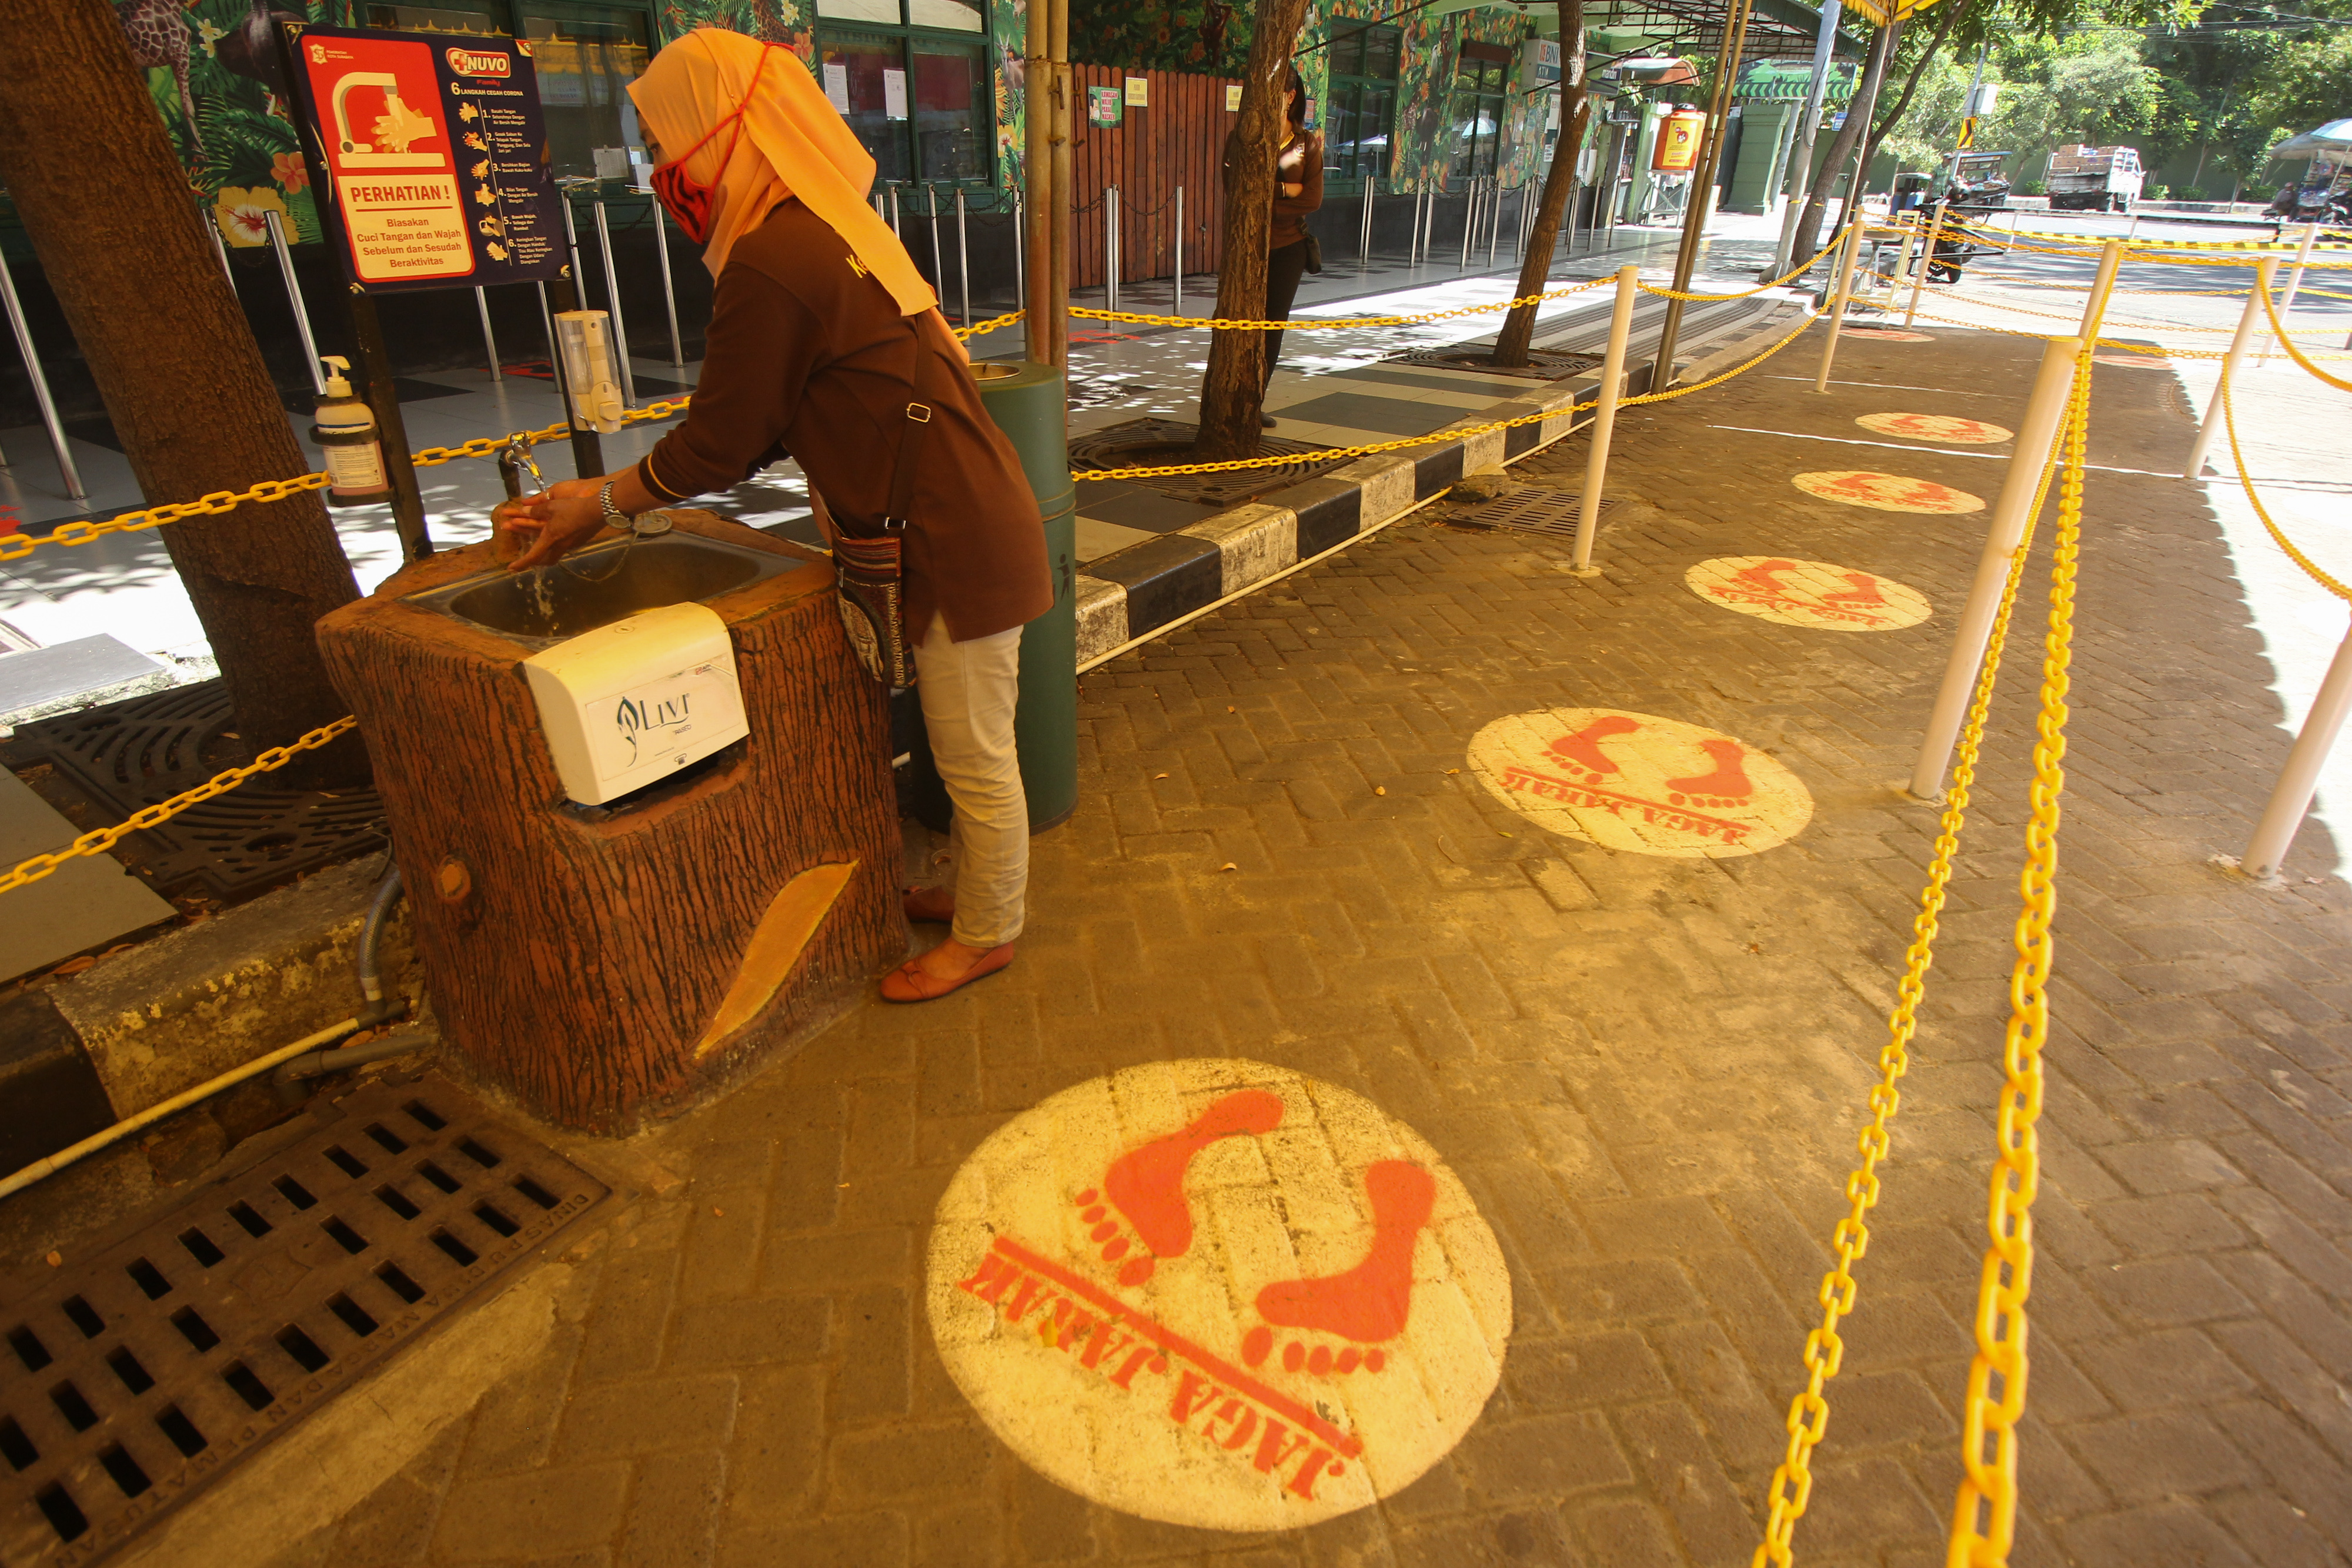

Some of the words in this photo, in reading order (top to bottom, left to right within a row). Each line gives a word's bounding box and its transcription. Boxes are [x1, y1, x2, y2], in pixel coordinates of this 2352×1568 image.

[1546, 45, 1559, 63] BNI
[467, 55, 507, 72] NUVO
[1538, 66, 1548, 79] ATM
[450, 82, 461, 95] 6
[476, 79, 501, 87] Family
[482, 109, 491, 118] 1.
[487, 132, 495, 141] 2.
[493, 163, 501, 172] 3.
[350, 185, 442, 202] PERHATIAN
[445, 185, 450, 200] !
[498, 188, 506, 196] 4.
[386, 218, 429, 228] Biasakan
[503, 216, 512, 225] 5.
[357, 233, 379, 242] Cuci
[381, 232, 414, 242] Tangan
[416, 231, 433, 239] dan
[434, 229, 462, 240] Wajah
[363, 246, 404, 256] Sebelum
[406, 245, 423, 253] dan
[425, 242, 462, 252] Sesudah
[508, 238, 517, 248] 6.
[390, 257, 444, 268] Beraktivitas
[1500, 773, 1632, 815] JARAK
[1642, 806, 1747, 845] JAGA
[957, 1251, 1168, 1391] JARAK
[1169, 1370, 1345, 1501] JAGA
